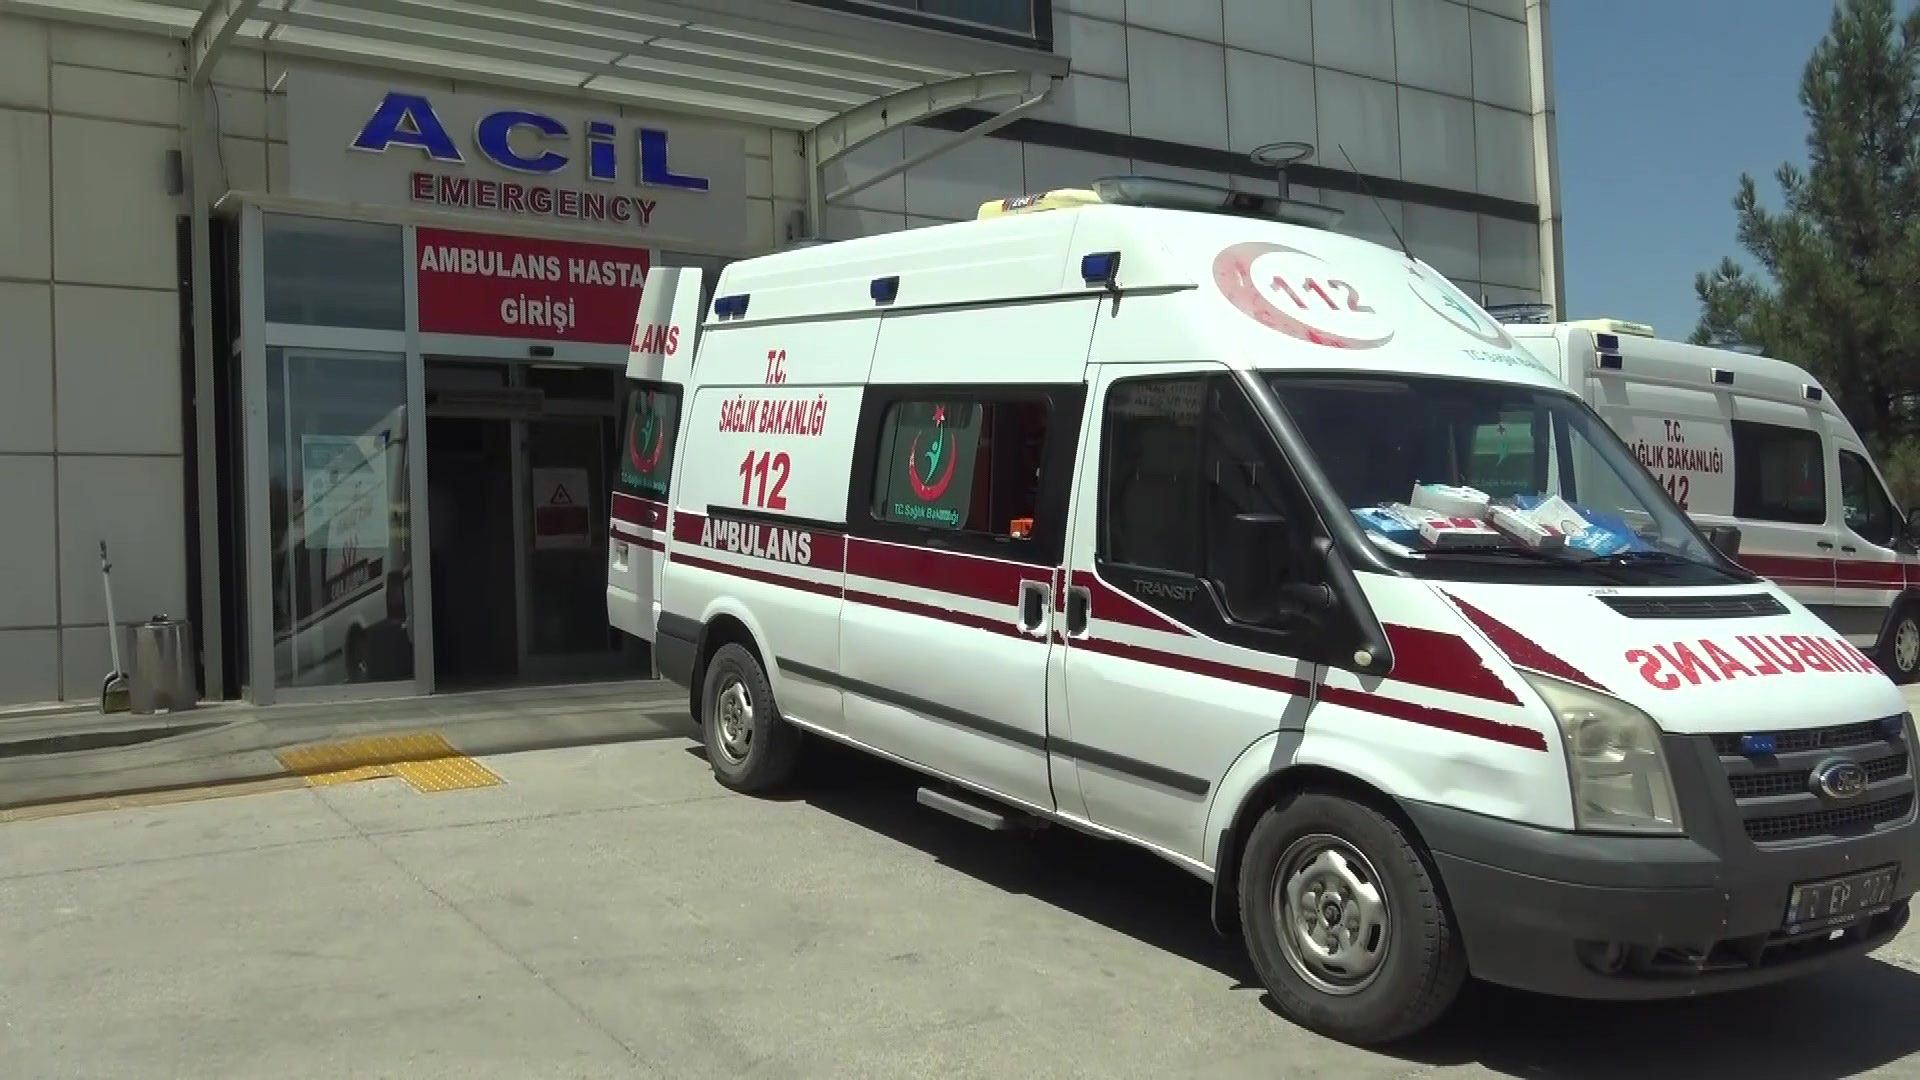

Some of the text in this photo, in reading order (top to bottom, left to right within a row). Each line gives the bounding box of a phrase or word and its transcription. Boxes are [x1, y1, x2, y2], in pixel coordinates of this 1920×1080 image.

[411, 171, 657, 225] EMERGENCY
[419, 245, 645, 289] AMBULANS HASTA
[500, 294, 576, 333] GİRİŞİ
[1270, 275, 1376, 314] 112
[631, 324, 680, 356] LANS
[765, 350, 787, 384] T.C.
[719, 393, 828, 436] SAĞLIK BAKANLIĞI
[1664, 419, 1685, 443] T.C.
[1628, 439, 1723, 474] AĞLIK BAKANLIĞI
[739, 450, 791, 510] 112
[700, 517, 812, 565] AMBULANS
[1133, 579, 1195, 601] TRANSIT
